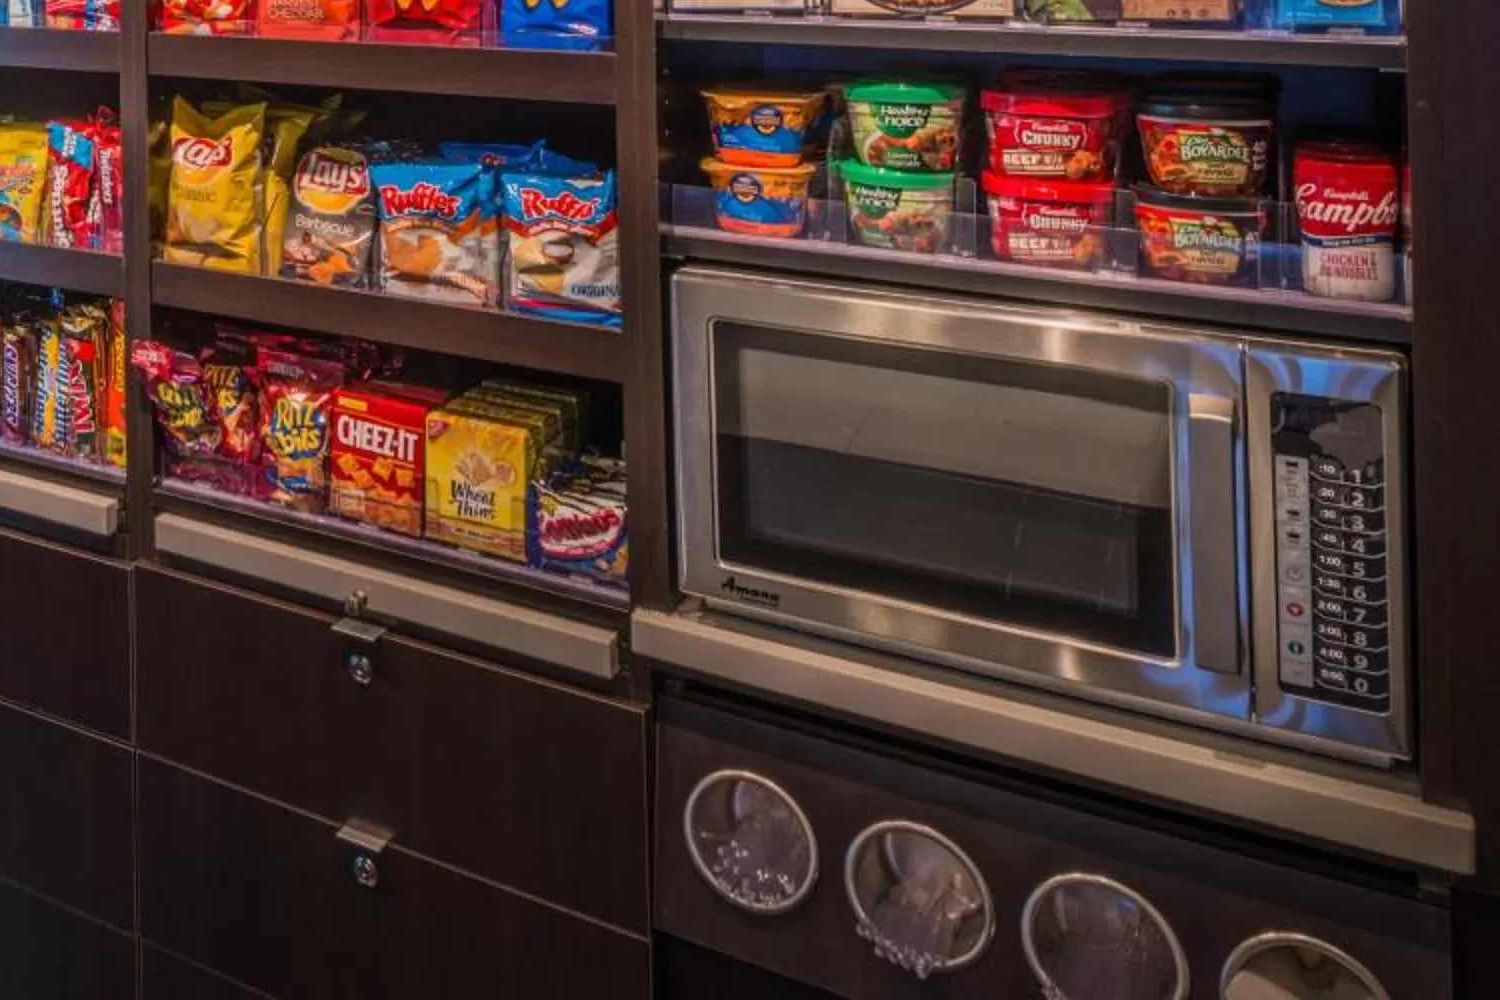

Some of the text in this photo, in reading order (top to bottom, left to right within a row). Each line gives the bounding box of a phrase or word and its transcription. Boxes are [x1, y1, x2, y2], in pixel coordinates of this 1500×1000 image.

[1021, 130, 1082, 149] CHUNKY
[1003, 152, 1041, 165] BEEF
[380, 182, 463, 217] Ruffles
[1029, 213, 1089, 232] CHUNKY
[336, 414, 418, 463] CHEEZ-IT
[1351, 469, 1361, 483] 1
[451, 479, 495, 507] Wheat
[1352, 491, 1365, 508] 2
[456, 499, 497, 521] Thins
[1352, 515, 1365, 532] 3
[1352, 539, 1365, 553] 4
[1353, 561, 1366, 577] 5
[722, 576, 780, 602] Amana
[1353, 585, 1367, 600] 6
[1353, 608, 1367, 624] 7
[1354, 631, 1368, 648] 8
[1354, 655, 1369, 669] 9
[1354, 678, 1369, 695] 0
